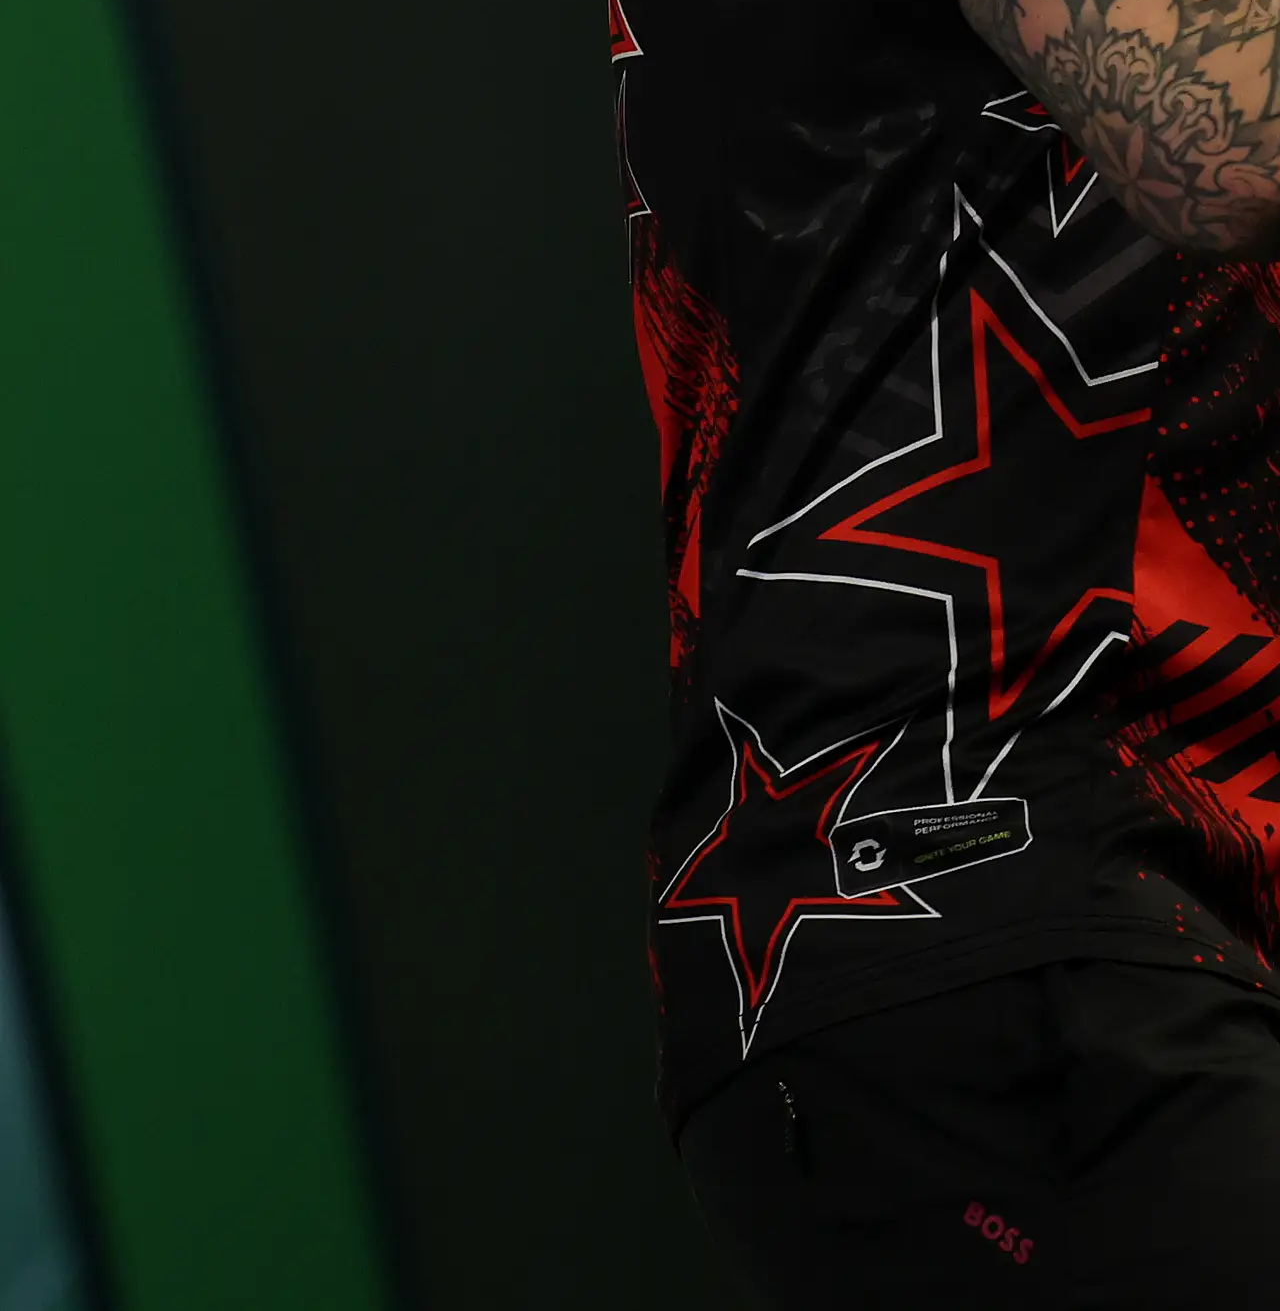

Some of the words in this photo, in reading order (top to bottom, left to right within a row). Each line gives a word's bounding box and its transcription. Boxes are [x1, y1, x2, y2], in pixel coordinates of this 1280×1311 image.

[913, 810, 999, 827] PROFESSIONAL
[914, 815, 1000, 836] PERFORMANCE
[947, 839, 977, 853] YOUR
[978, 830, 1011, 844] GAME
[963, 1200, 1034, 1264] BOSS
